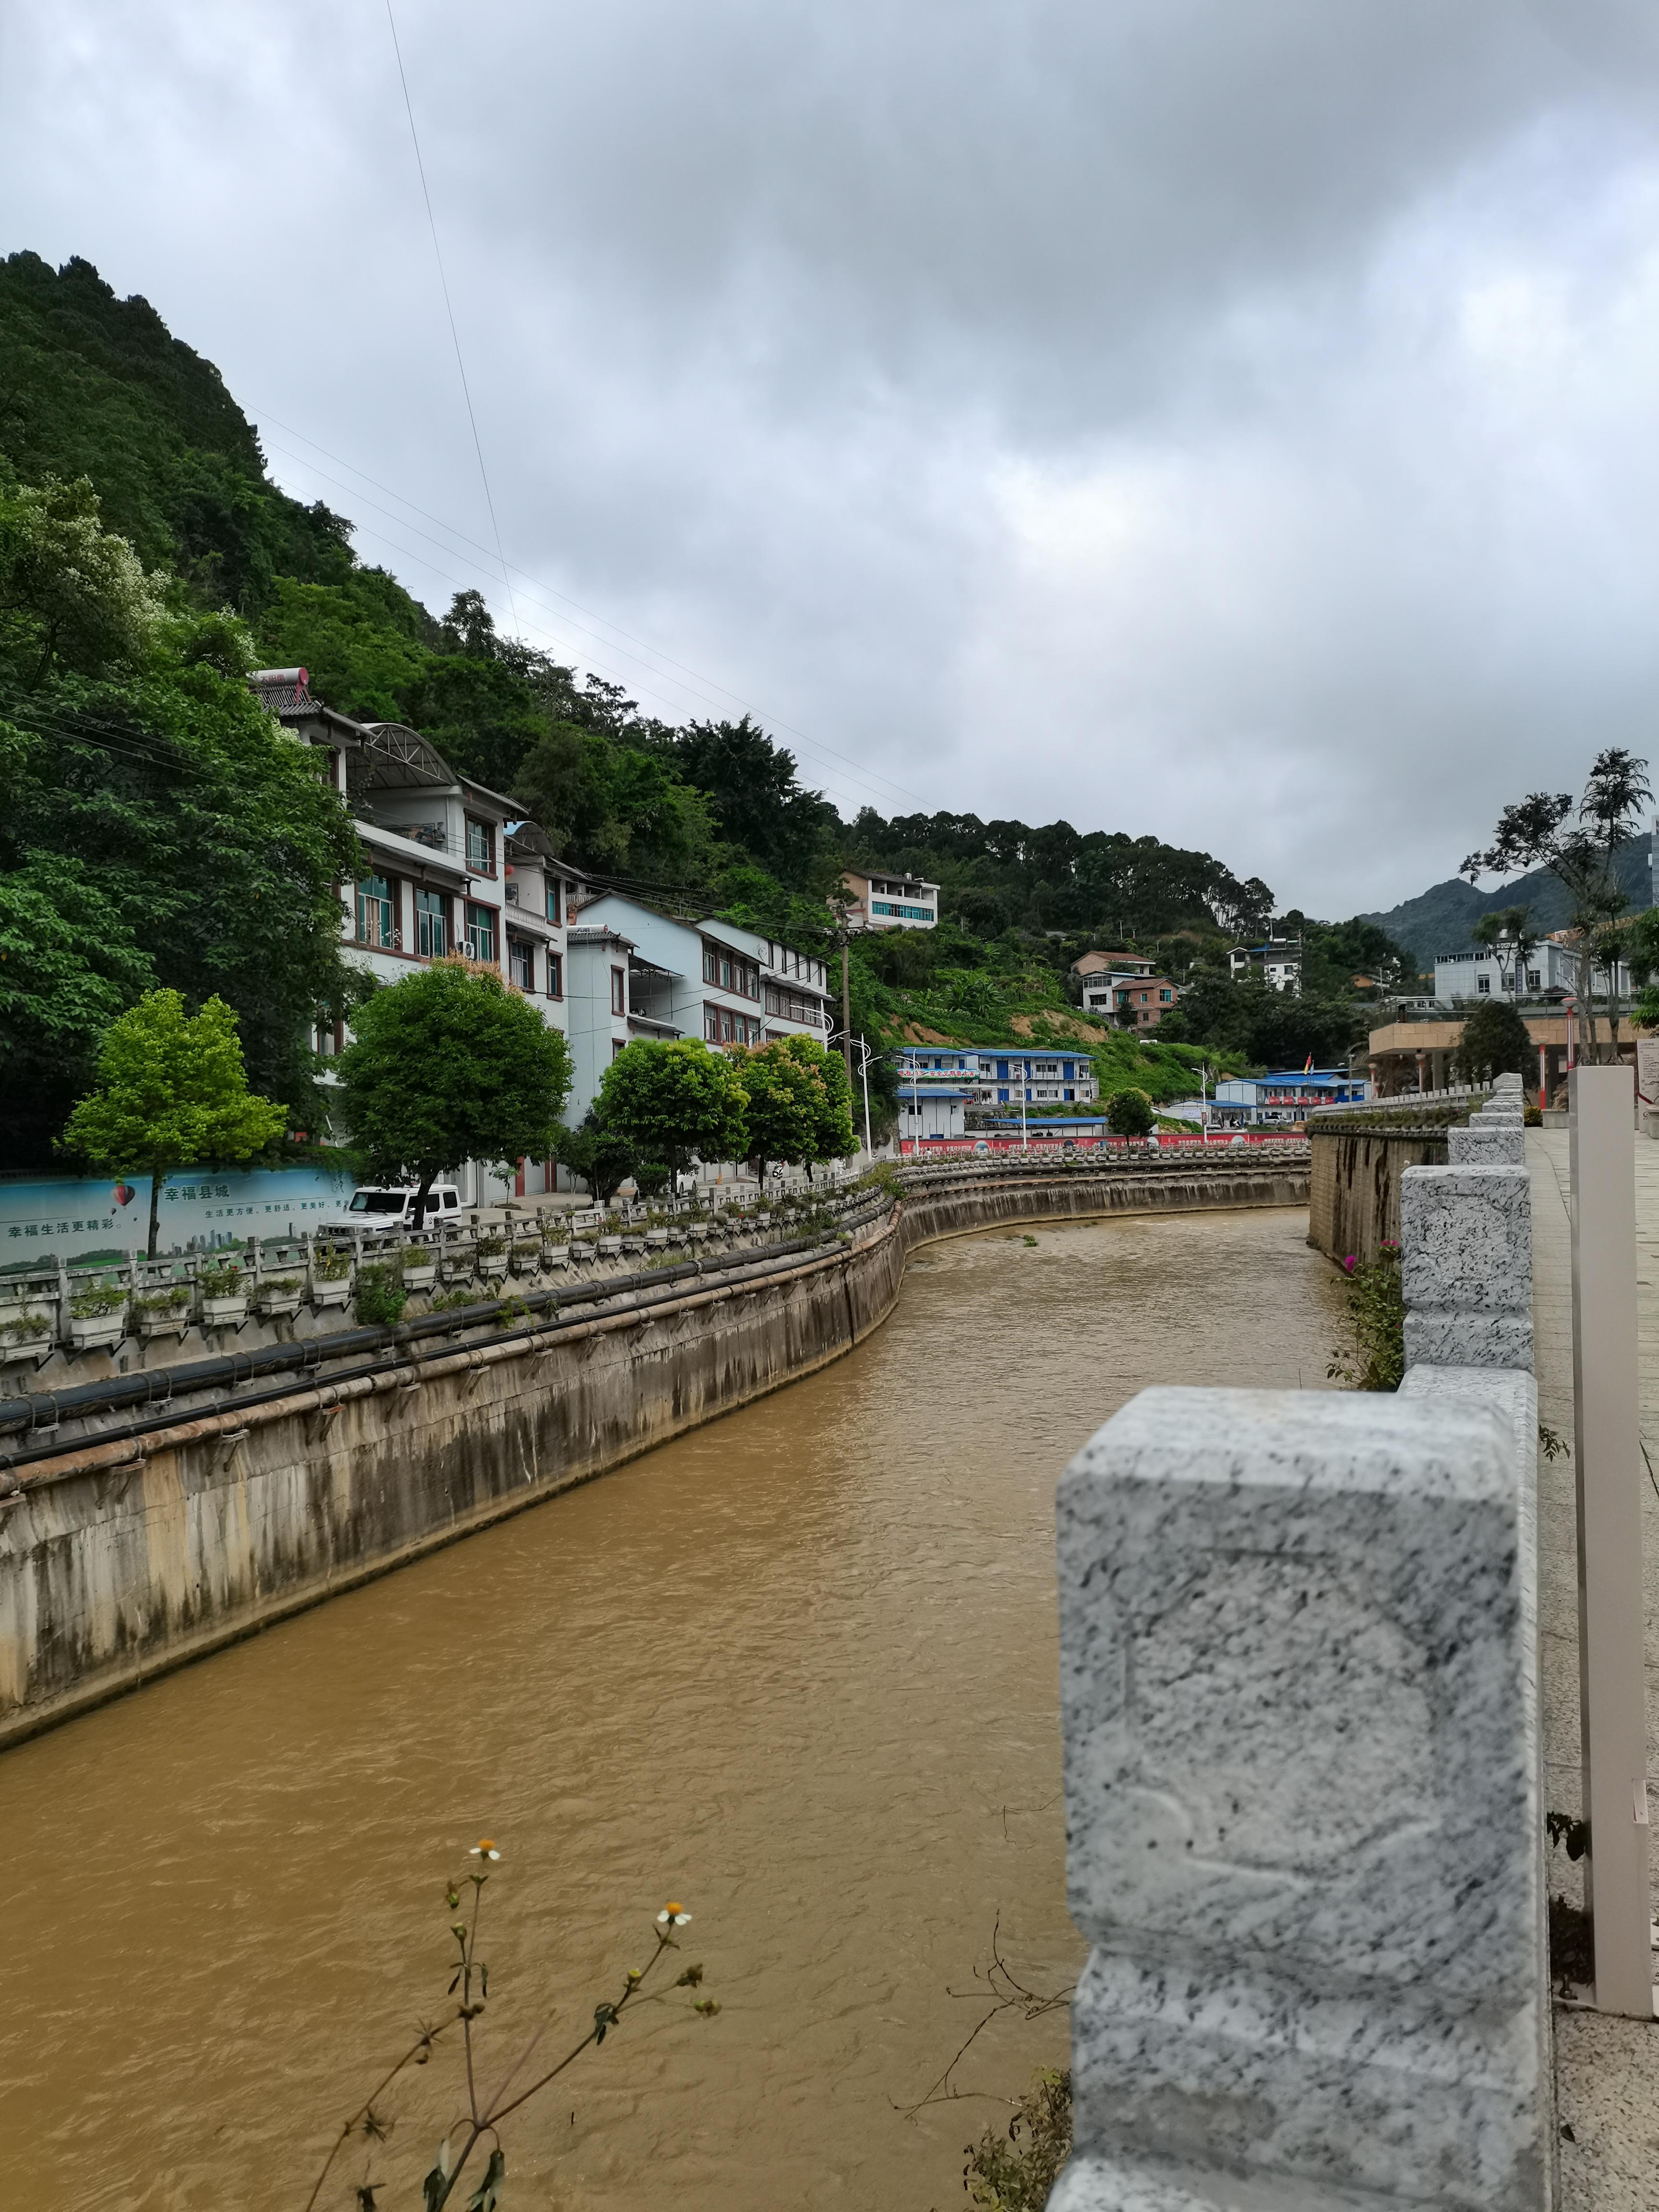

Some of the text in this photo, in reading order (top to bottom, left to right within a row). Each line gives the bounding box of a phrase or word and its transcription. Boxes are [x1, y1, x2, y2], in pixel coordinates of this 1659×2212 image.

[164, 1184, 229, 1202] 幸福县城
[8, 1218, 121, 1238] 幸福生活更精彩。
